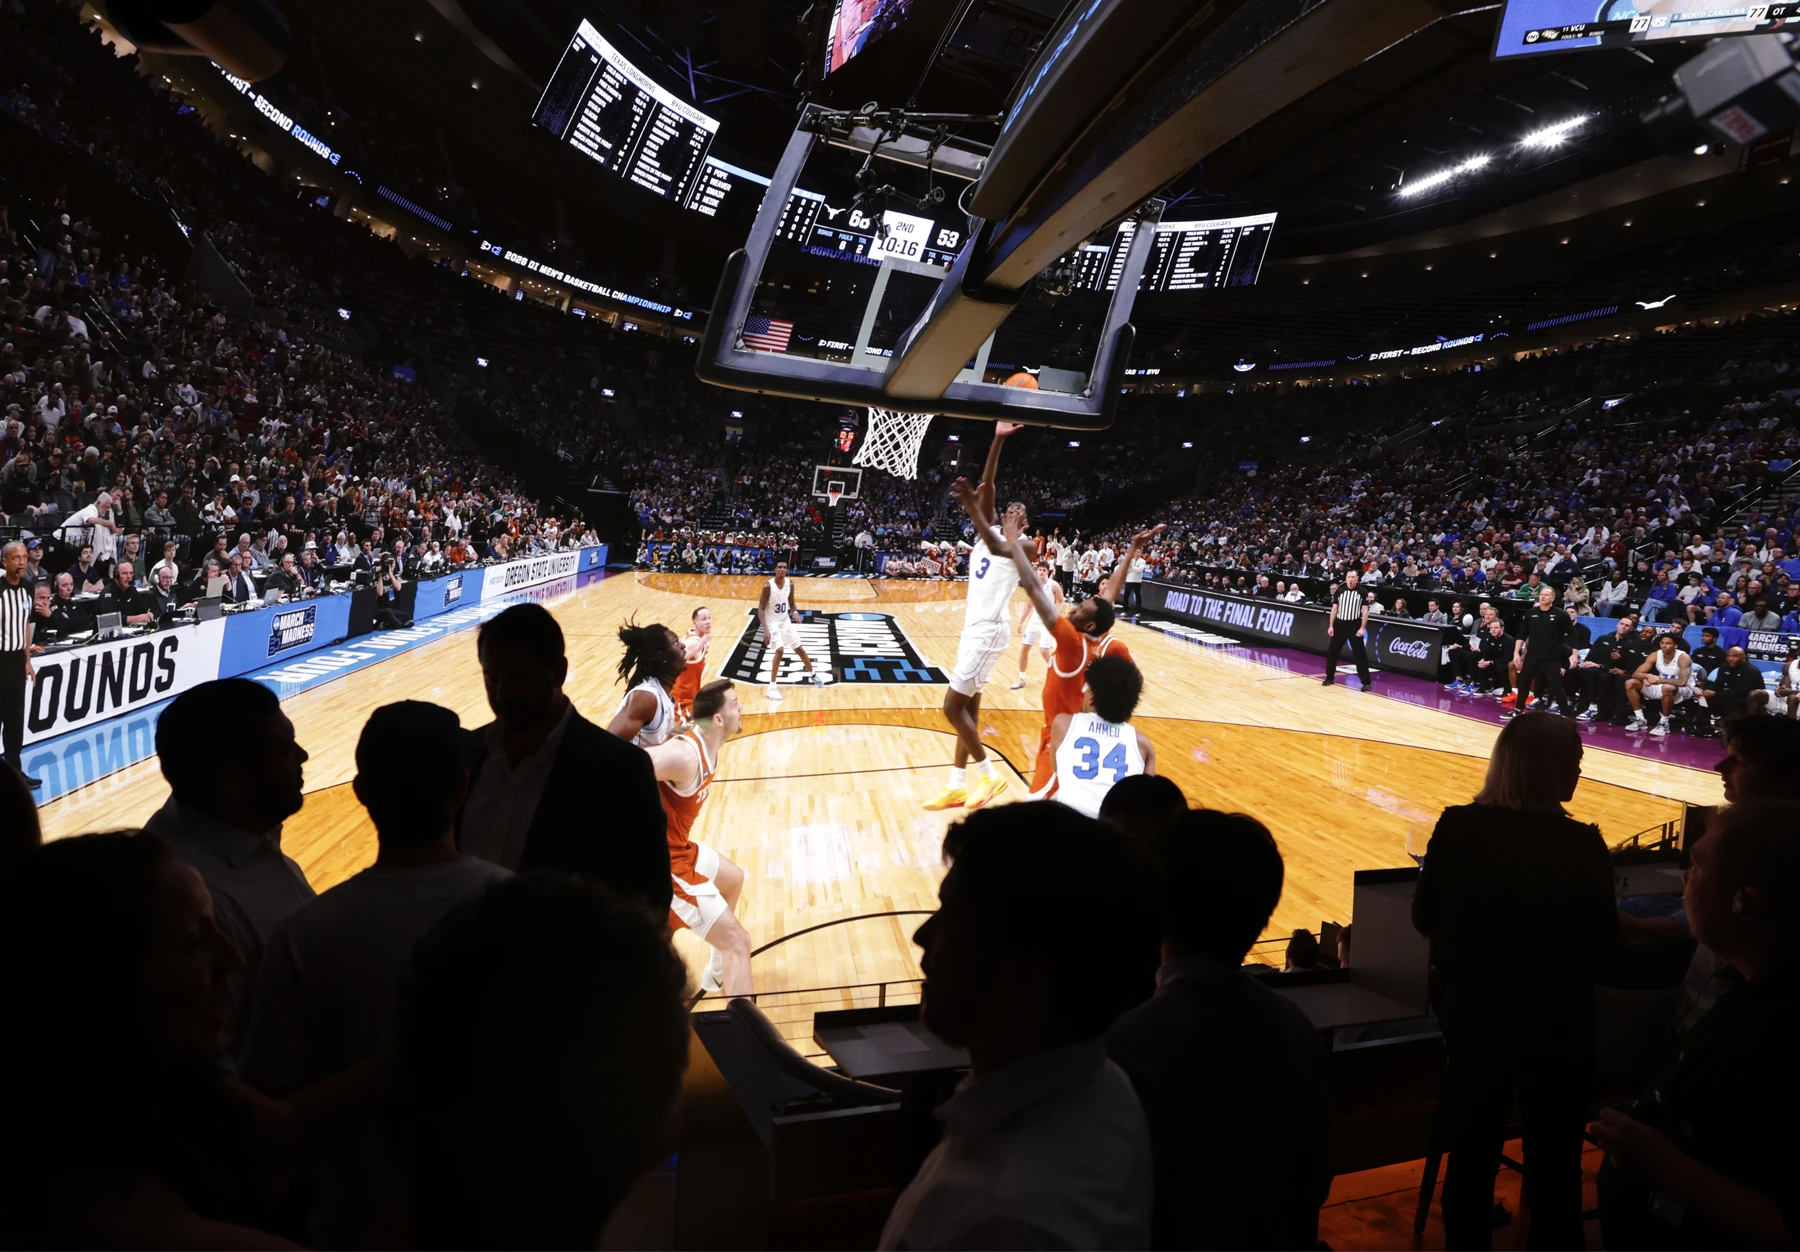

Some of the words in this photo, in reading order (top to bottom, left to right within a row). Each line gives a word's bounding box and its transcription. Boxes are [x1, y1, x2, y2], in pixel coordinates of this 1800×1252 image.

[1707, 8, 1745, 18] CAROLINA
[1750, 8, 1767, 18] 77
[1772, 7, 1786, 16] OT
[1632, 18, 1648, 29] 77
[611, 53, 628, 70] TEXAS
[626, 66, 656, 93] LONGHORNS
[671, 100, 682, 110] BYU
[683, 106, 706, 124] COUGARS
[254, 94, 294, 131] SECOND
[291, 124, 331, 159] ROUNDS
[710, 178, 732, 191] WEAVER
[713, 168, 729, 180] POPE
[838, 232, 853, 241] FOULS
[896, 221, 915, 234] 2ND
[856, 244, 864, 254] 2
[877, 237, 919, 257] 10:16
[937, 229, 960, 248] 53
[504, 251, 528, 267] 2026
[539, 264, 564, 280] MEN'S
[563, 275, 611, 297] BASKETBALL
[611, 290, 672, 314] CHAMPIONSHIP
[826, 340, 849, 350] FIRST
[1378, 350, 1403, 359] FIRST
[1411, 343, 1442, 355] SECOND
[1442, 336, 1474, 349] ROUNDS
[504, 565, 529, 587] OREGON
[531, 561, 548, 580] STATE
[547, 555, 576, 575] UNIVERSITY
[922, 558, 940, 571] DEFENSE
[975, 557, 990, 579] 3
[775, 603, 787, 613] 30
[1164, 590, 1190, 612] ROAD
[1189, 596, 1204, 616] TO
[1203, 598, 1226, 621] THE
[1222, 602, 1255, 629] FINAL
[1255, 608, 1294, 636] FOUR
[280, 611, 304, 630] MARCH
[281, 623, 314, 645] MADNESS
[834, 619, 906, 656] MARCH
[1389, 637, 1432, 659] Coca-Cola
[253, 650, 377, 683] FOUR
[28, 635, 178, 734] OUNDS
[1088, 721, 1121, 738] AHMED
[1072, 736, 1128, 783] 34
